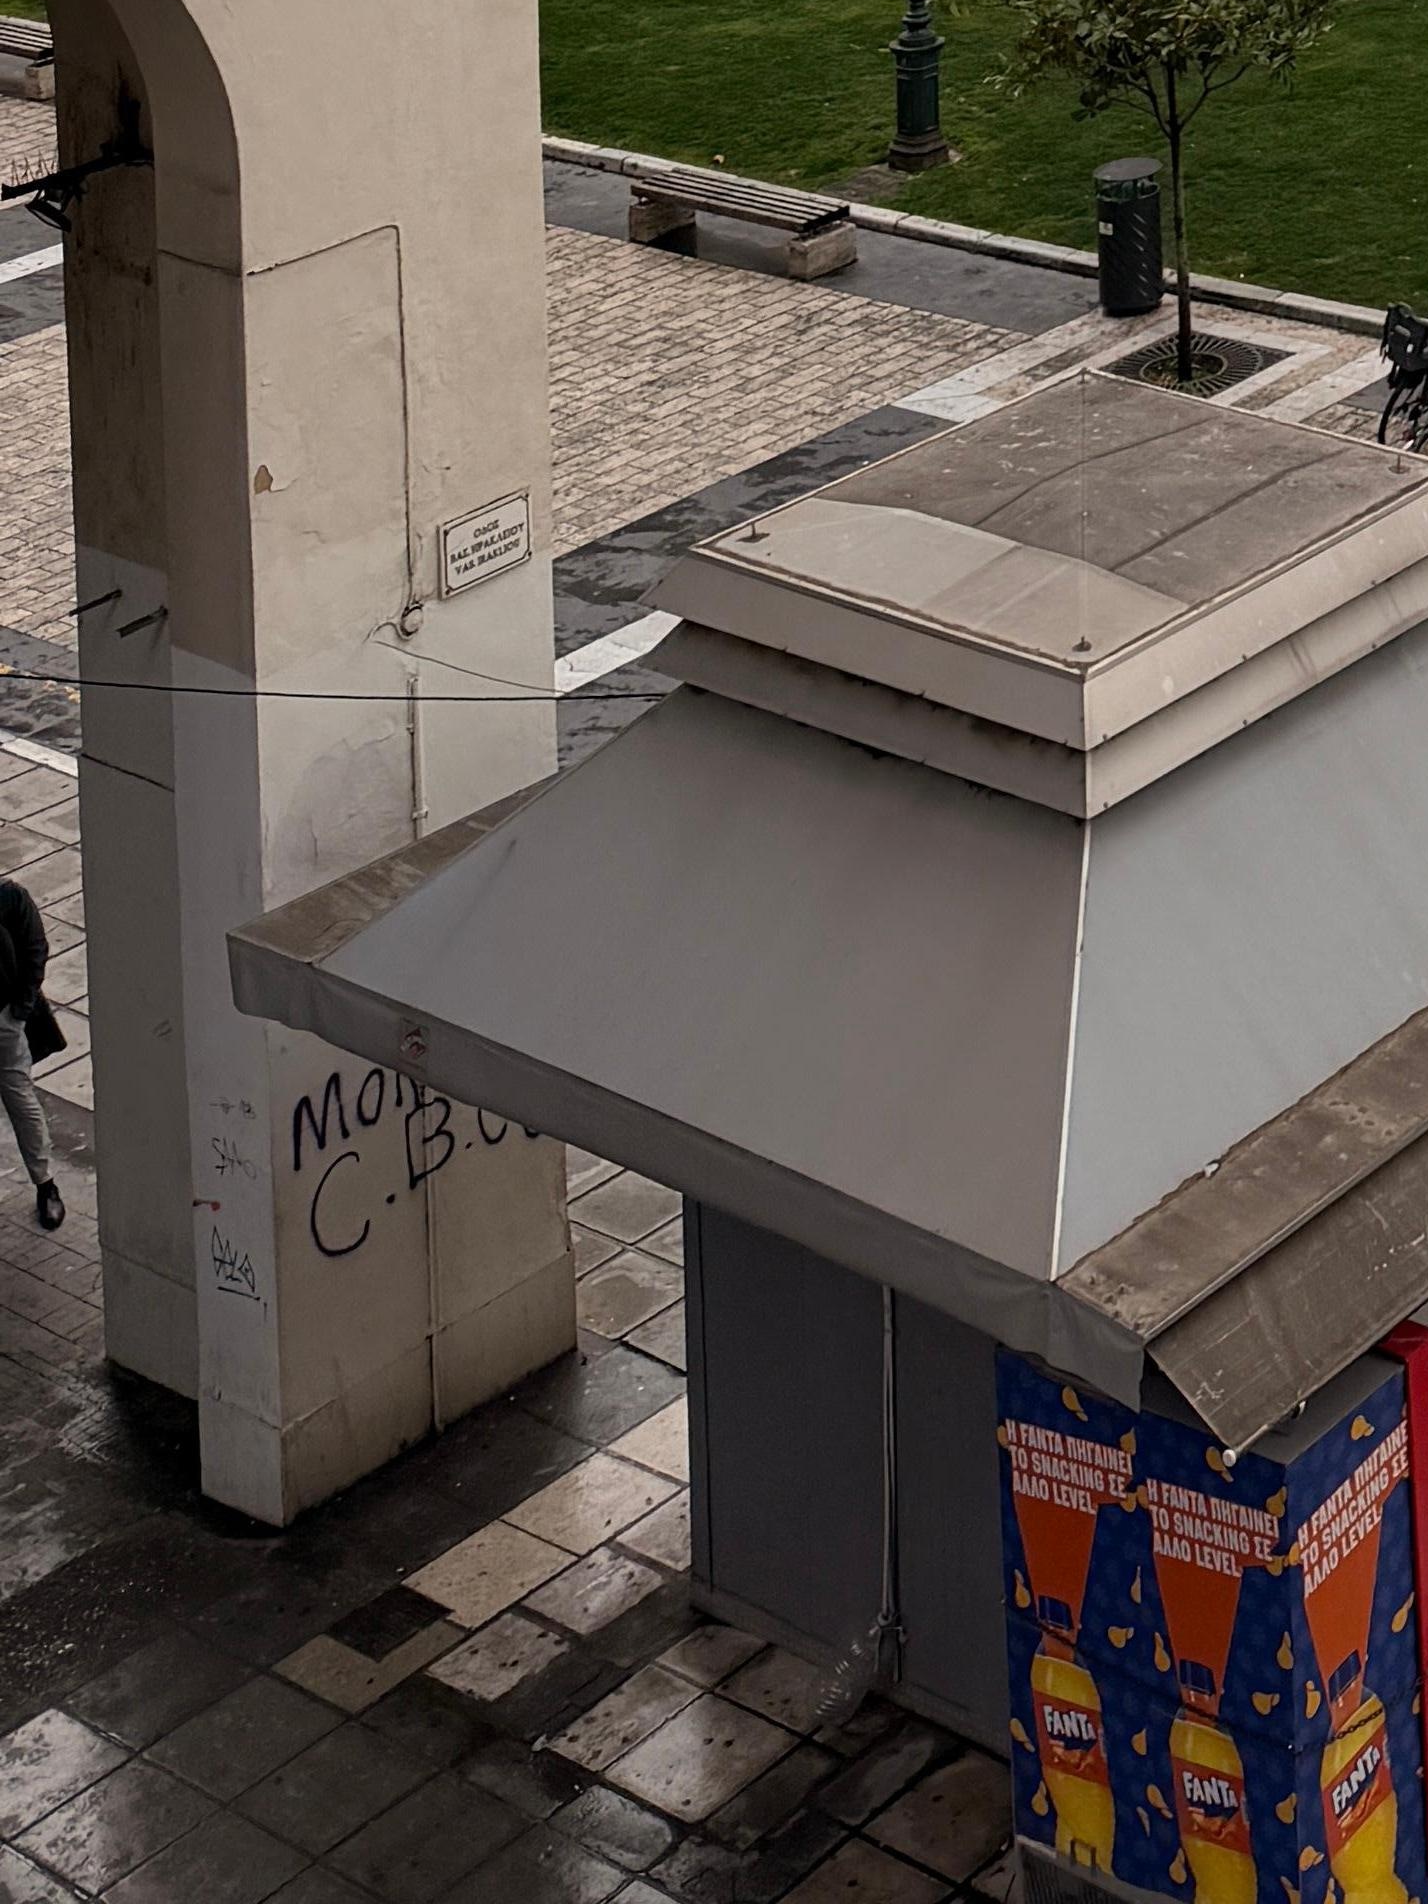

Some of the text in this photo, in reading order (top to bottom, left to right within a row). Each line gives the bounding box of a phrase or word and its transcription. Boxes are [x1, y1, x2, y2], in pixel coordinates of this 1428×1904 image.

[1020, 1422, 1064, 1455] FANTA
[1008, 1444, 1127, 1499] ΤΟ SNACKING ΣΕ
[1311, 1478, 1353, 1536] FANTA
[1354, 1419, 1408, 1490] ΠΗΓΑΙΝΕ
[1052, 1482, 1097, 1515] LEVEL
[1161, 1482, 1207, 1517] FANTA
[1300, 1445, 1408, 1573] ΤΟ SNACKING ΣΕ
[1148, 1504, 1273, 1562] ΤΟ SNACKING ΣΕ
[1342, 1503, 1382, 1558] LEVEL
[1195, 1543, 1242, 1578] LEVEL
[1042, 1705, 1097, 1741] FANTA
[1182, 1771, 1238, 1808] FANTA
[1332, 1744, 1382, 1815] FANTA
